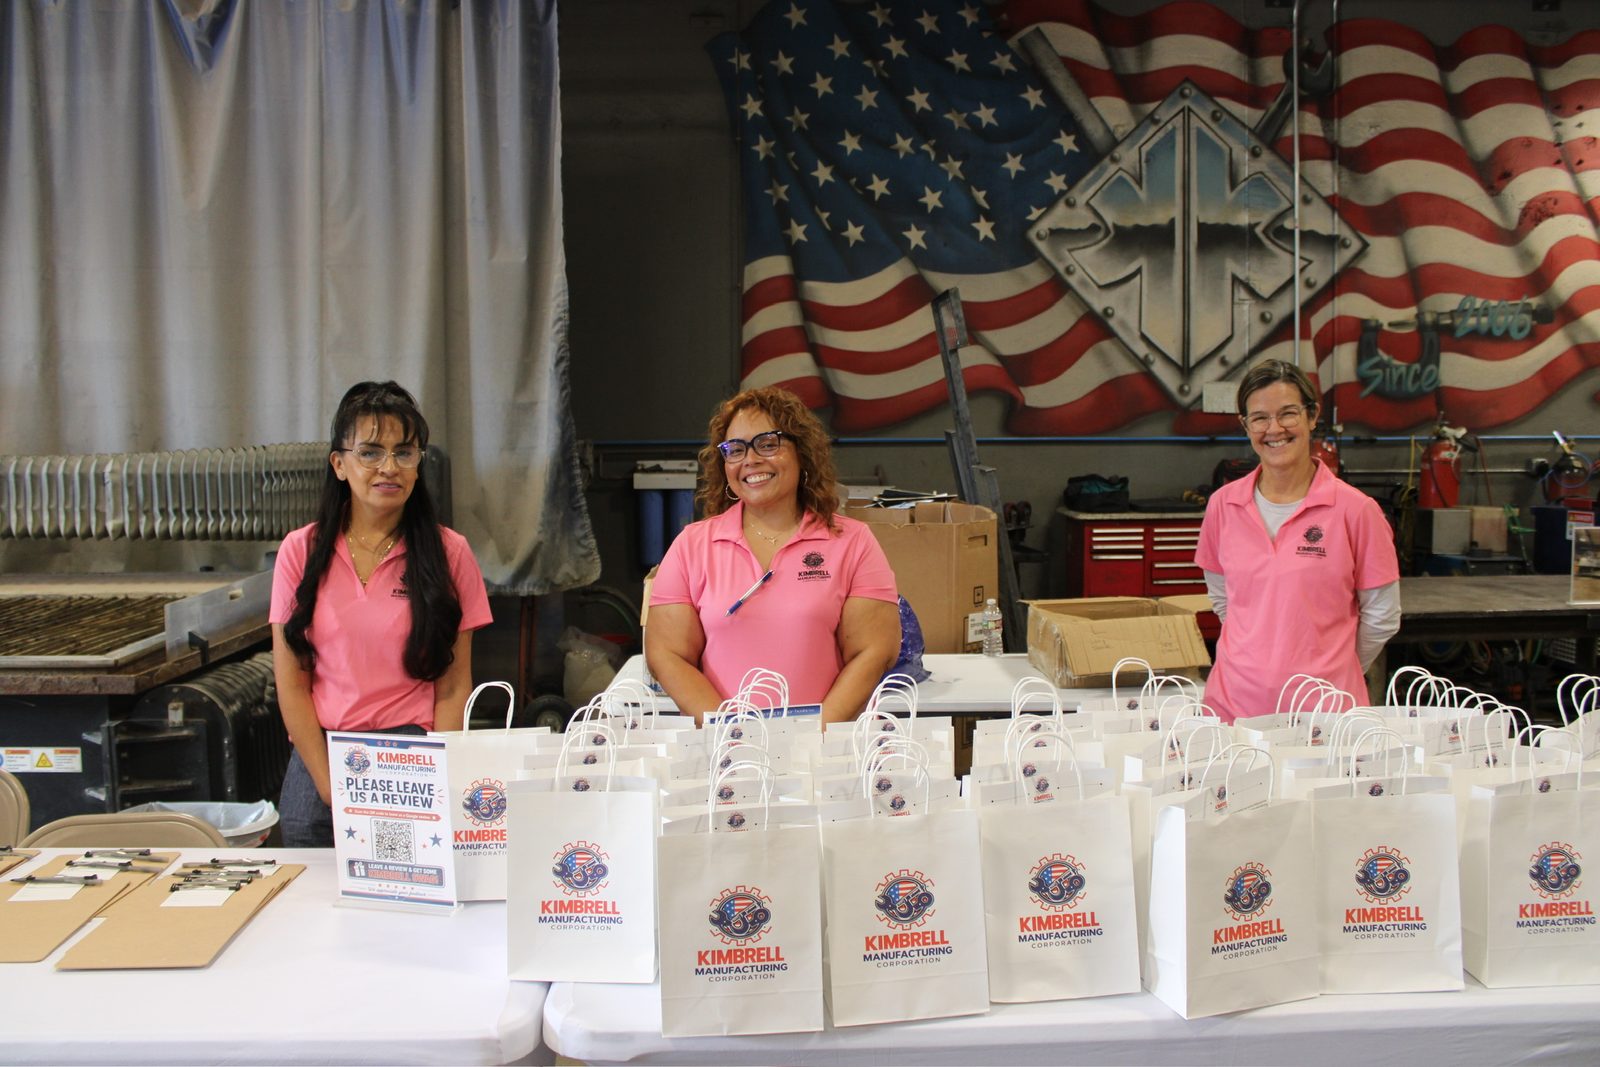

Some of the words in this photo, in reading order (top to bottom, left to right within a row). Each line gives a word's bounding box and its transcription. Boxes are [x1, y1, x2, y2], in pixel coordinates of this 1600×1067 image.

[1455, 294, 1532, 340] 2006
[1357, 355, 1439, 399] Since
[377, 752, 436, 766] KIMBRELL
[377, 764, 436, 773] MANUFACTURING
[346, 778, 393, 792] PLEASE
[396, 781, 435, 796] LEAVE
[350, 792, 366, 803] US
[371, 792, 379, 803] A
[382, 794, 433, 809] REVIEW
[454, 829, 507, 842] KIMBRE
[541, 900, 620, 914] KIMBRELL
[1519, 901, 1593, 918] KIMBRELL
[538, 916, 623, 924] MANUFACTURING
[1019, 912, 1099, 932] KIMBRELL
[1345, 906, 1423, 924] KIMBRELL
[1516, 917, 1596, 928] MANUFACTURING
[1018, 928, 1103, 942] MANUFACTURING
[1213, 918, 1284, 944] KIMBRELL
[1343, 923, 1427, 934] MANUFACTURING
[865, 930, 949, 951] KIMBRELL
[1031, 938, 1092, 949] CORPORATION
[1211, 934, 1287, 955] MANUFACTURING
[697, 946, 784, 966] KIMBRELL
[863, 946, 953, 962] MANUFACTURING
[1223, 945, 1278, 960] CORPORATION
[695, 963, 788, 976] MANUFACTURING
[877, 958, 941, 968] CORPORATION
[708, 973, 775, 982] CORPORATION
